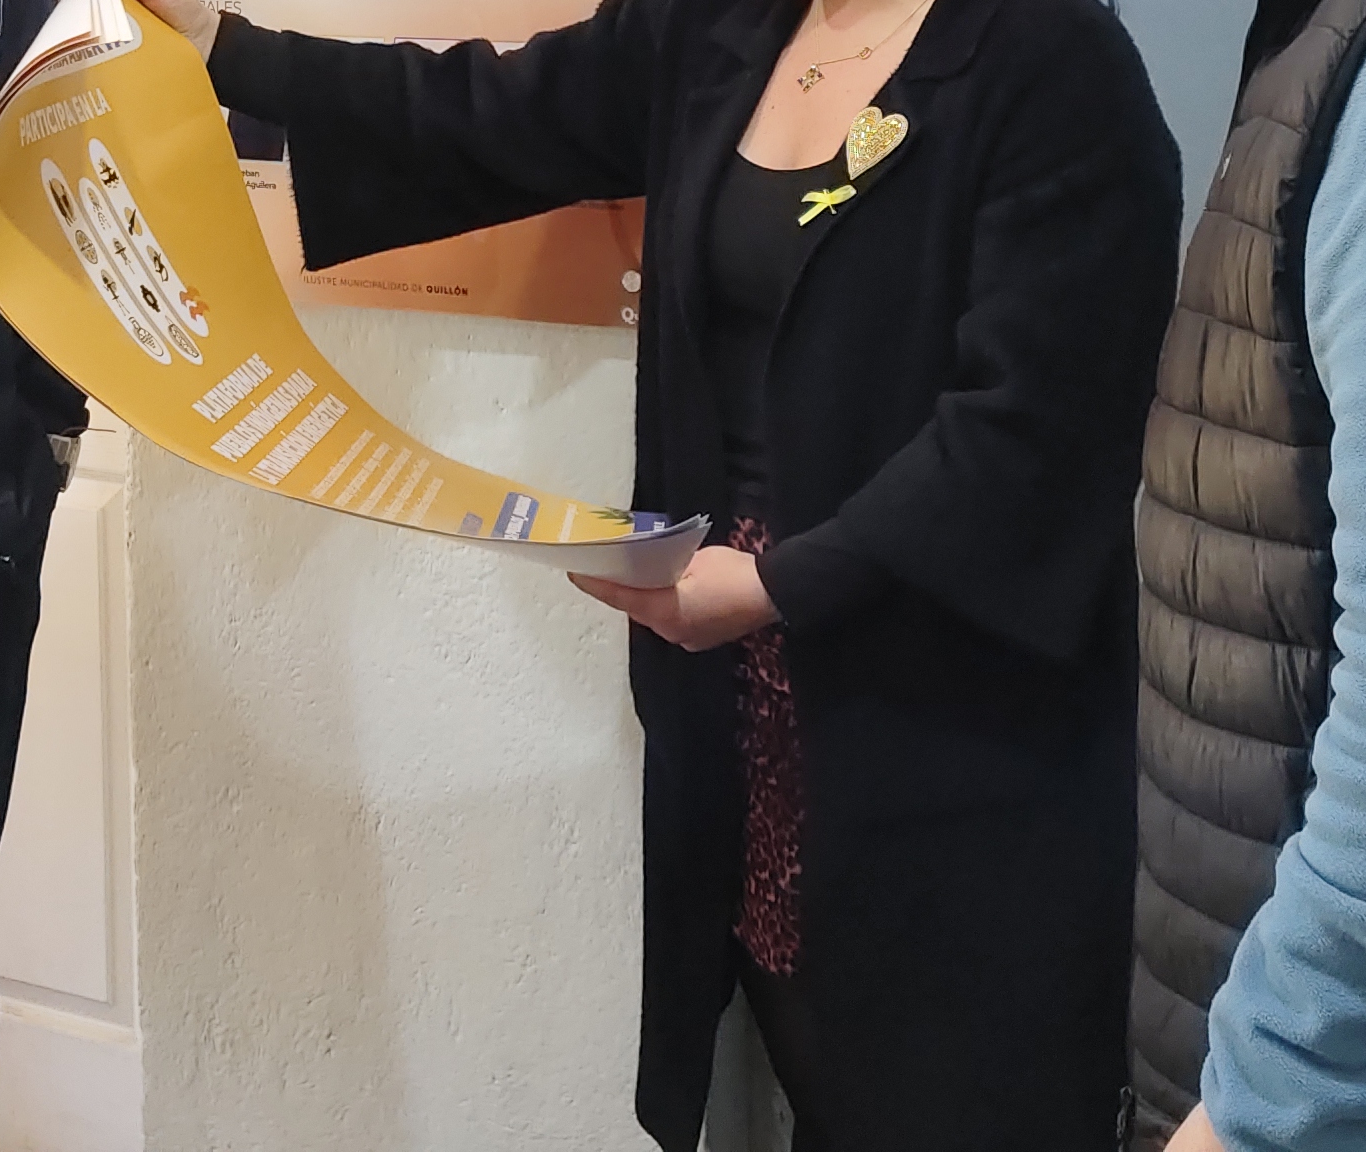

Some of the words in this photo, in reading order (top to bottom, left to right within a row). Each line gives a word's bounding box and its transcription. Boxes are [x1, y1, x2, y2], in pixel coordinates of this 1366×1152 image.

[19, 100, 75, 147] PARTICIPA
[73, 90, 95, 125] EN
[88, 88, 112, 119] LA
[303, 275, 337, 287] ILUSTRE
[340, 278, 409, 292] MUNICIPALIDAD
[411, 284, 423, 293] DE
[426, 285, 468, 296] QUILLÓN
[191, 361, 261, 424] PLATAFORMA
[246, 352, 274, 383] DE
[210, 420, 265, 463] PUEBLOS
[278, 368, 318, 403] PARA
